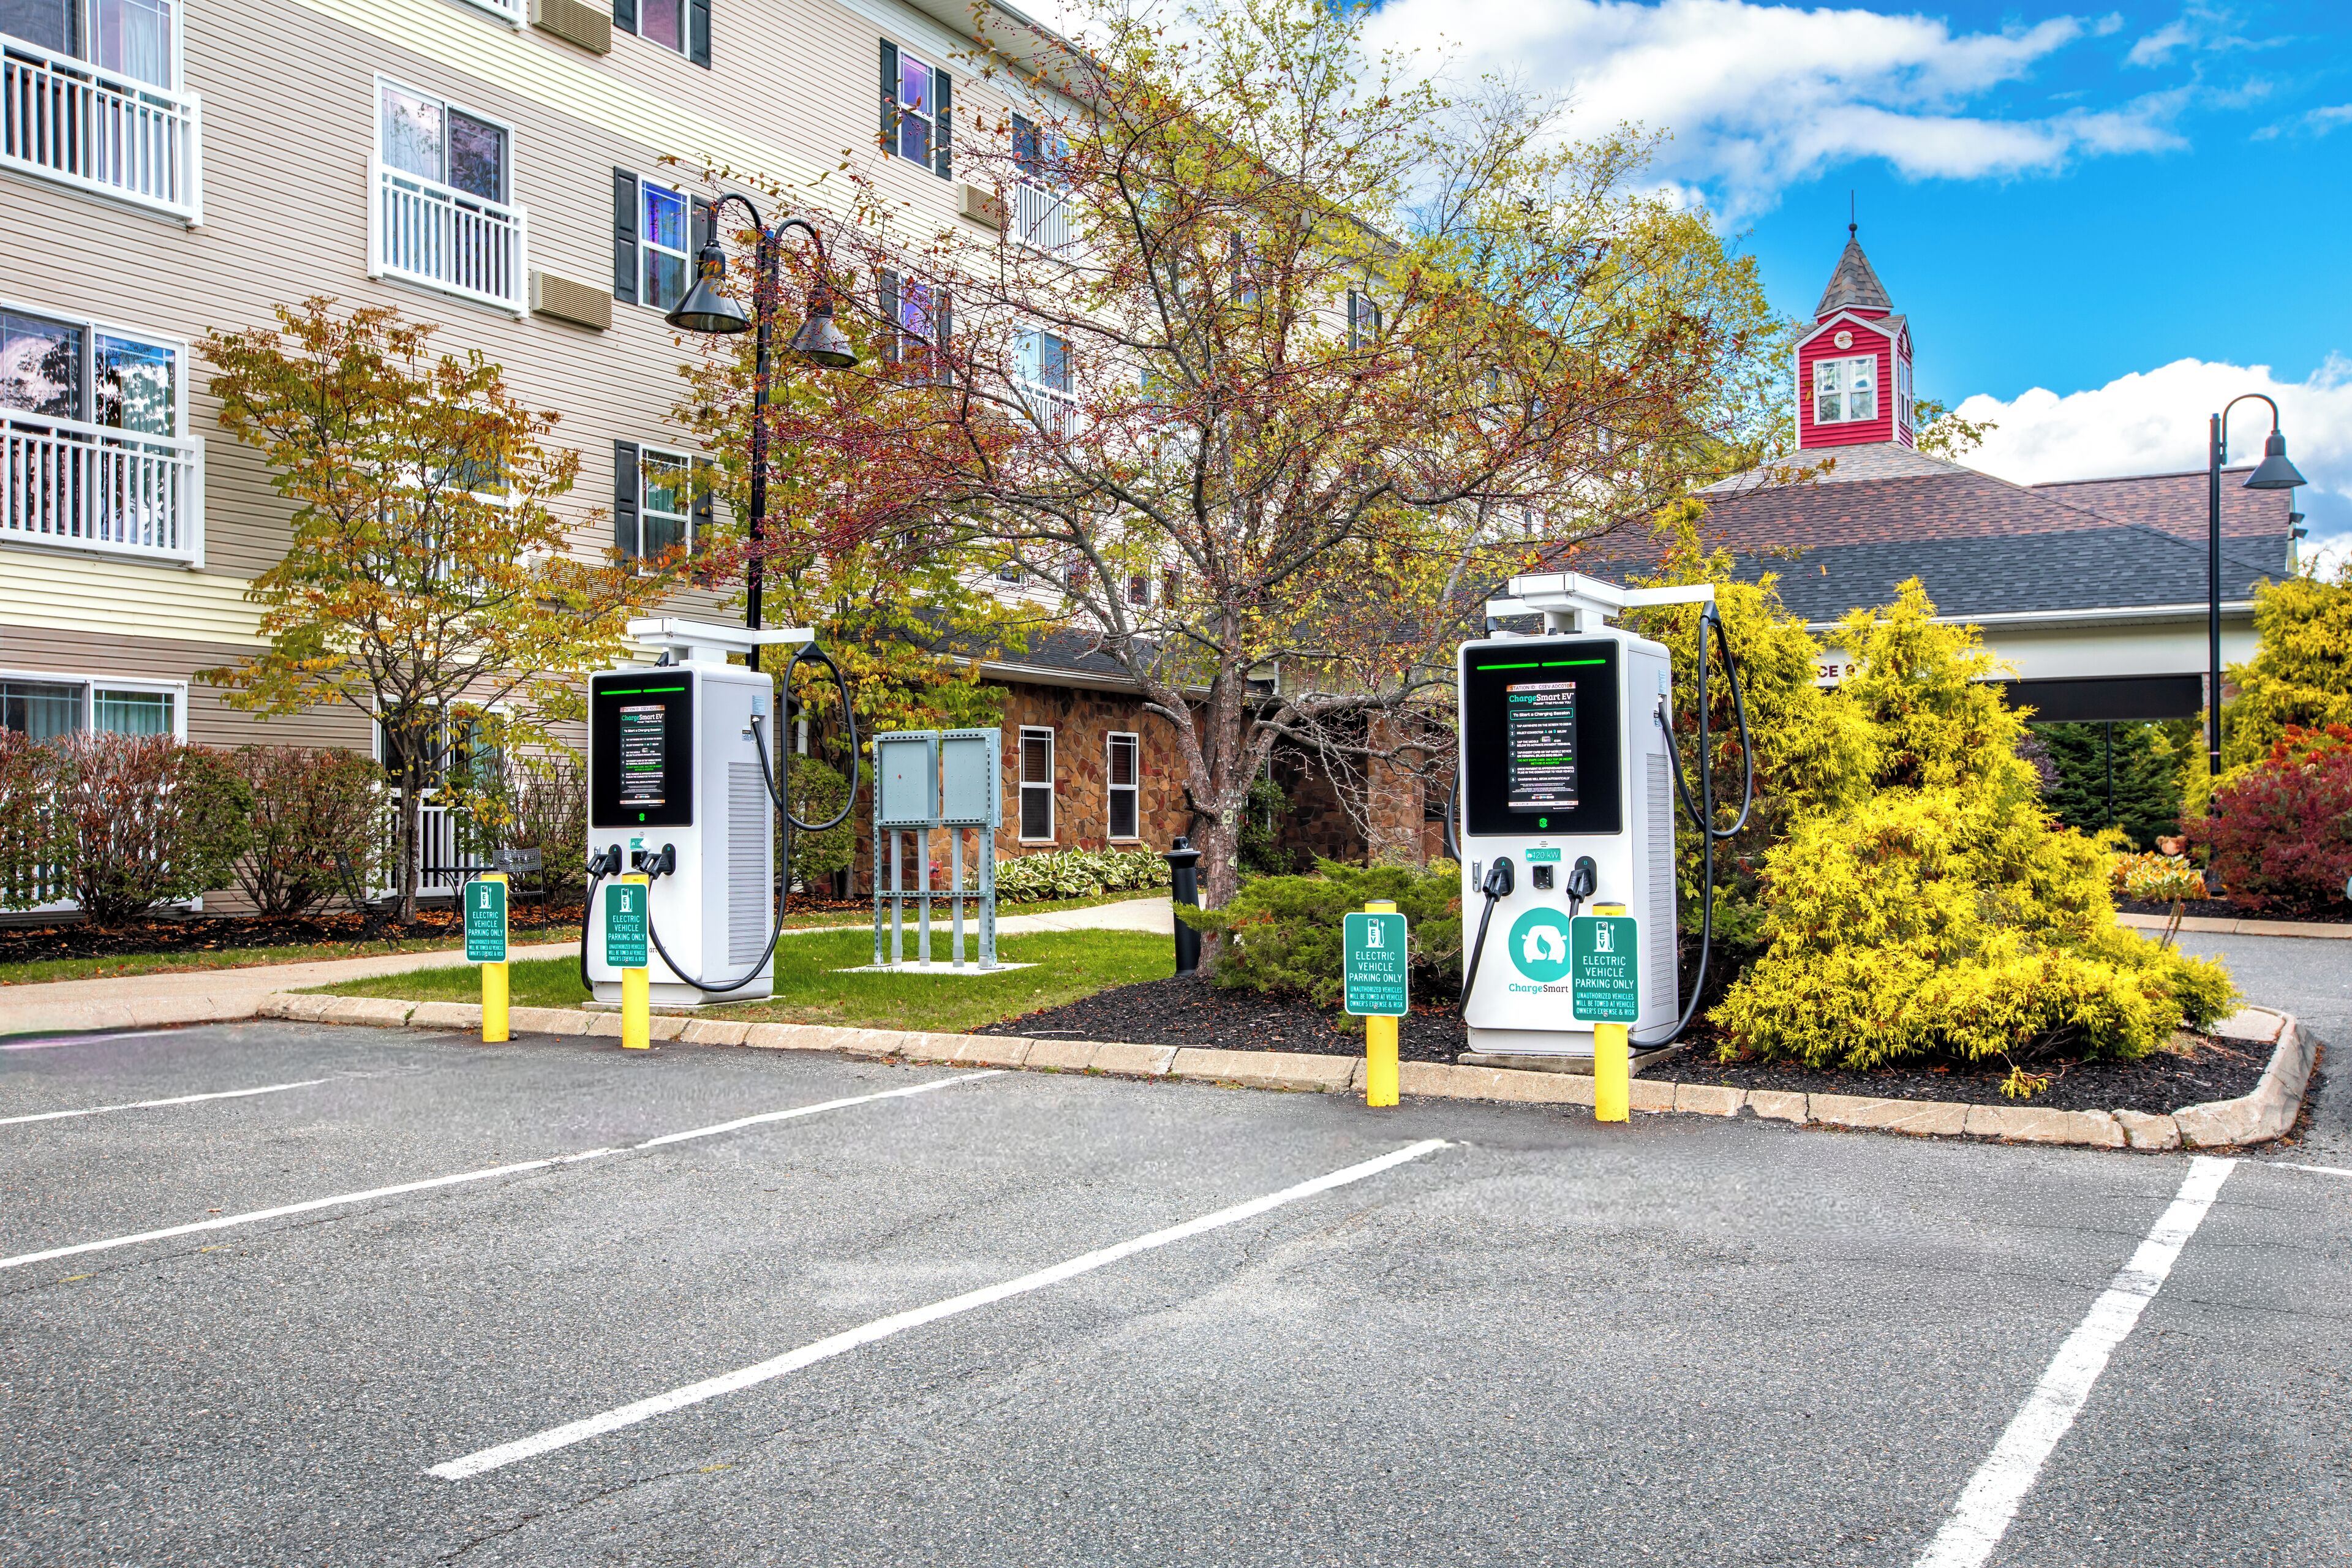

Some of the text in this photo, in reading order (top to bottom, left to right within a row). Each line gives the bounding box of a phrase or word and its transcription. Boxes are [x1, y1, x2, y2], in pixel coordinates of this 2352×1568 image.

[1509, 694, 1560, 703] ChargeSmart
[1356, 951, 1395, 960] ELECTRIC
[1583, 956, 1626, 965] ELECTRIC
[1359, 962, 1393, 971] VEHICLE
[1585, 967, 1624, 977] VEHICLE
[1349, 973, 1402, 982] PARKING ONLY
[1509, 983, 1568, 994] ChargeSmart
[1575, 979, 1634, 989] PARKING ONLY
